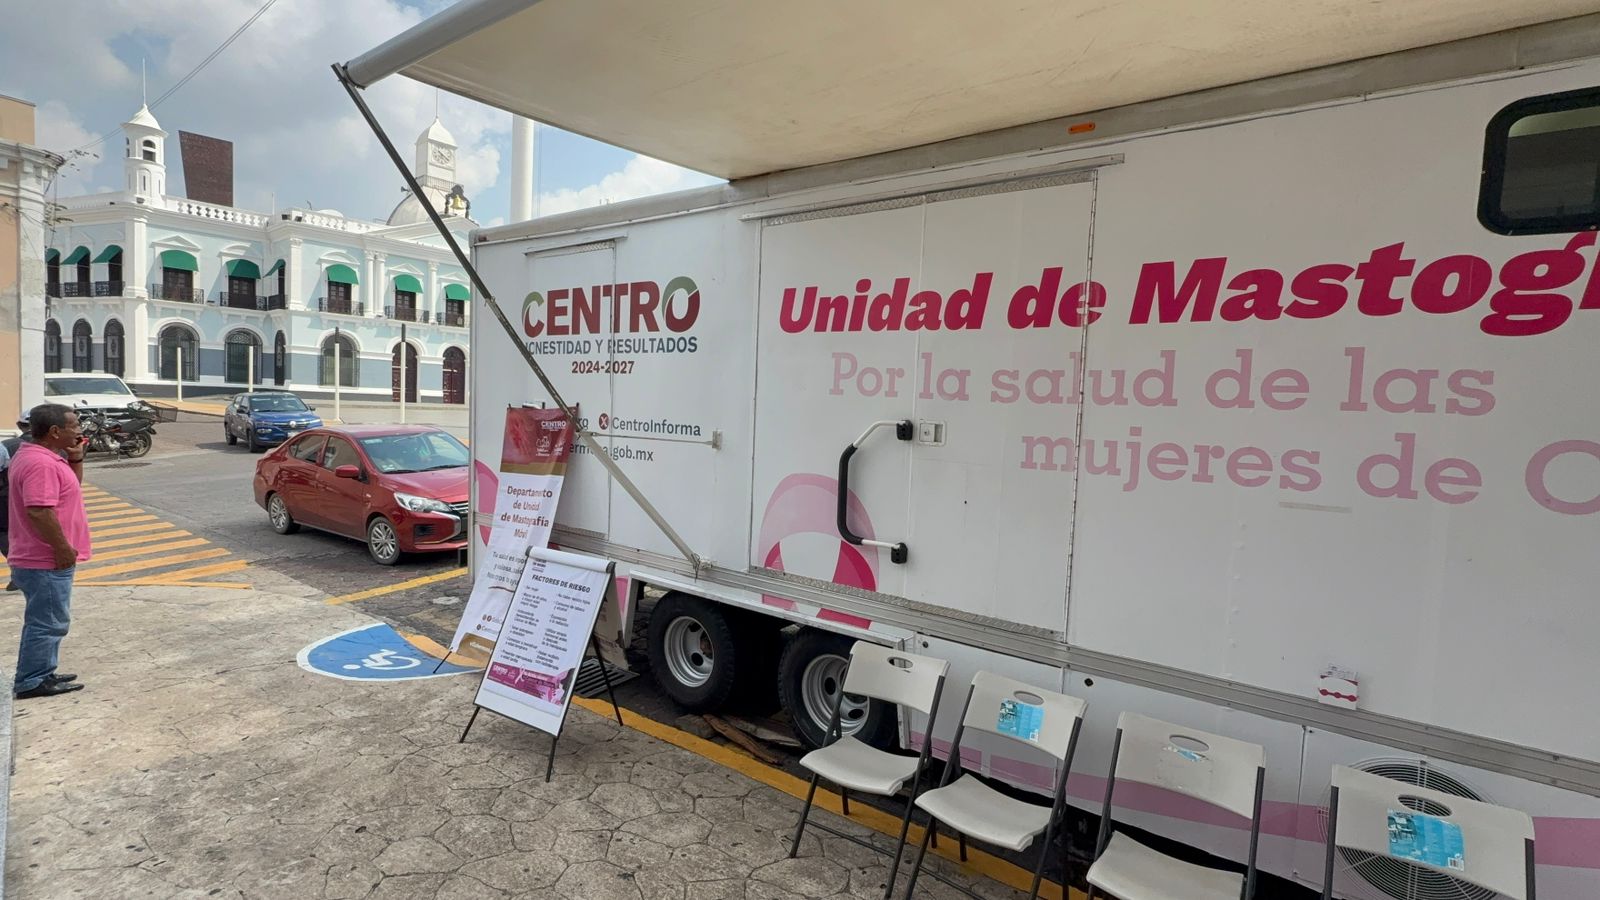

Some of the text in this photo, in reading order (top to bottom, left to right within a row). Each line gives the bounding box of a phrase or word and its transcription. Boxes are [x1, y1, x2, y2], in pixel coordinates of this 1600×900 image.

[522, 276, 700, 338] CENTRO
[779, 272, 994, 333] Unidad
[1007, 267, 1107, 328] de
[595, 339, 603, 354] Y
[608, 336, 698, 354] RESULTADOS
[571, 360, 634, 375] 2024-2027
[828, 346, 1496, 417] Por la salud de las
[612, 417, 701, 437] CentroInforma
[1020, 426, 1322, 492] mujeres
[1356, 433, 1482, 504] de
[513, 500, 522, 510] de
[501, 513, 511, 522] de
[532, 574, 591, 593] FACTORES DE RIESGO
